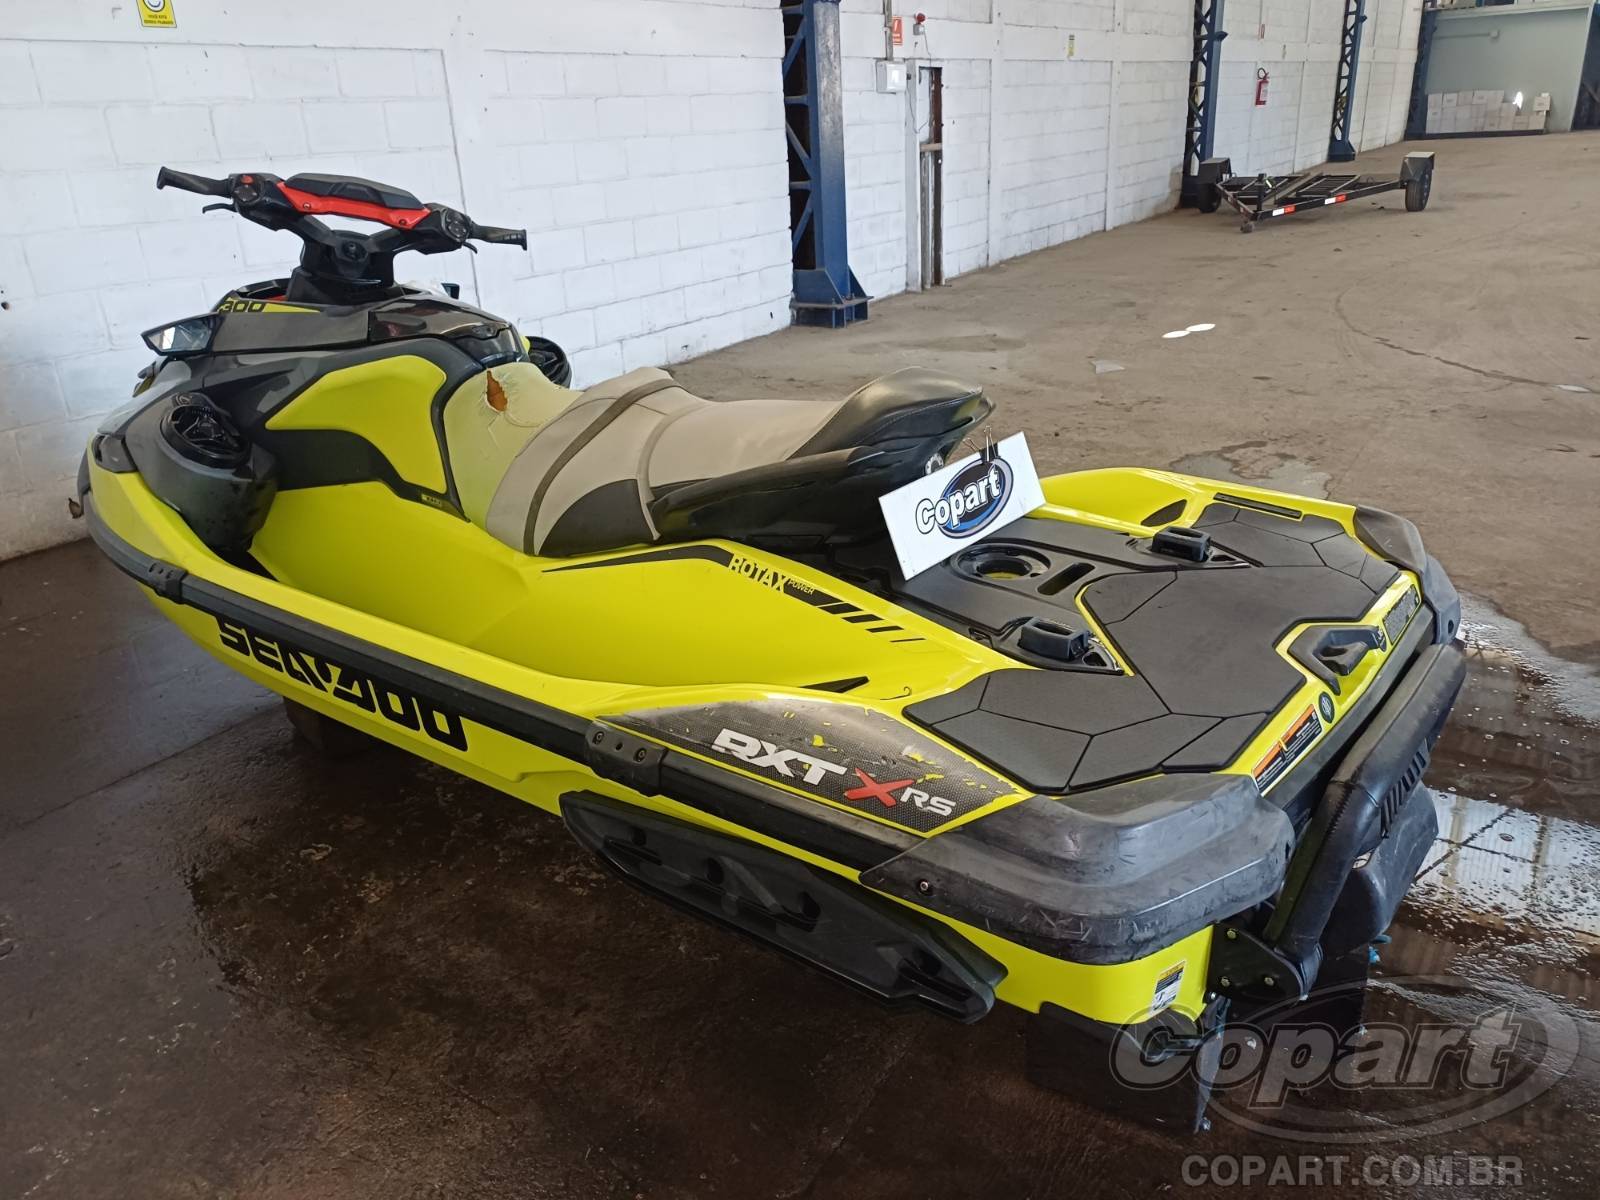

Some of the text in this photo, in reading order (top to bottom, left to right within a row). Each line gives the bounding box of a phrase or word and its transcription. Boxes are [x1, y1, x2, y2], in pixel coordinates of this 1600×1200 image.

[915, 461, 1002, 535] Copart
[728, 554, 815, 595] ROTAX POWER
[711, 728, 847, 786] RXT
